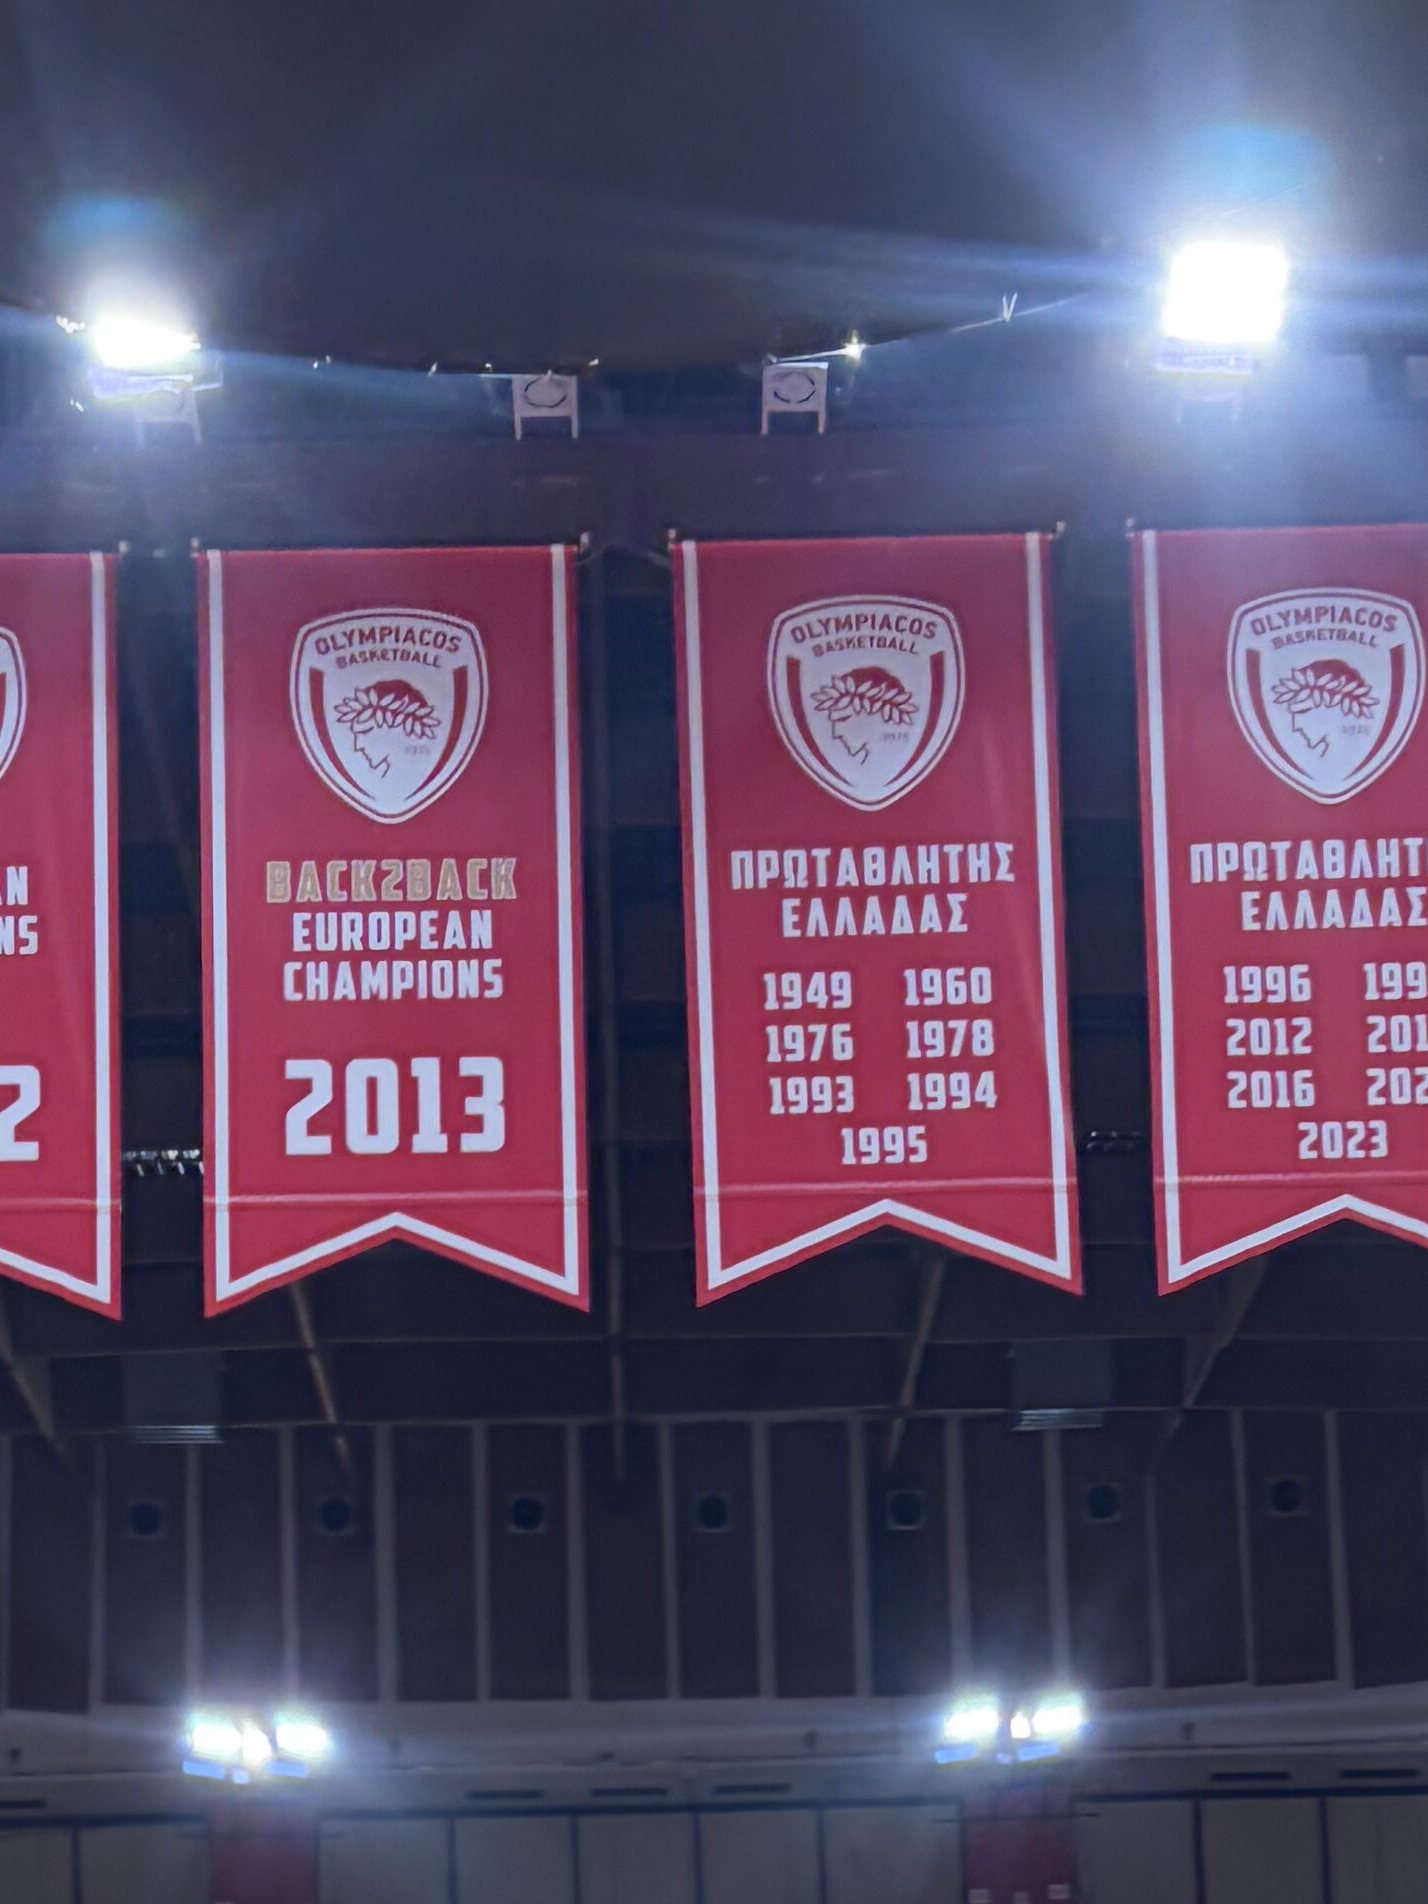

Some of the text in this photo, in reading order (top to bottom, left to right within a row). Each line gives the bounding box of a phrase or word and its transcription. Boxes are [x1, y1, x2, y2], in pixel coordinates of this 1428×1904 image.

[315, 626, 462, 655] OLYMPIACOS
[791, 614, 937, 644] OLYMPIACOS
[1250, 605, 1398, 636] OLYMPIACOS
[266, 857, 517, 903] BACK2BACK
[731, 842, 1014, 889] ΠΡΩΤΑΘΛΗΤΗΣ
[782, 893, 968, 937] ΕΛΛΑΔΑΣ
[1240, 886, 1428, 931] ΕΛΛΑΔΑΣ
[293, 909, 492, 952] EUROPEAN
[284, 958, 503, 1000] CHAMPIONS
[763, 967, 992, 1010] 1949 1960
[1223, 964, 1312, 1004] 1996
[765, 1019, 995, 1062] 1976 1978
[1226, 1016, 1312, 1056] 2012
[285, 1056, 505, 1155] 2013
[769, 1071, 997, 1115] 1993 1994
[1227, 1069, 1315, 1109] 2016
[841, 1125, 928, 1165] 1995
[1298, 1119, 1388, 1160] 2023
